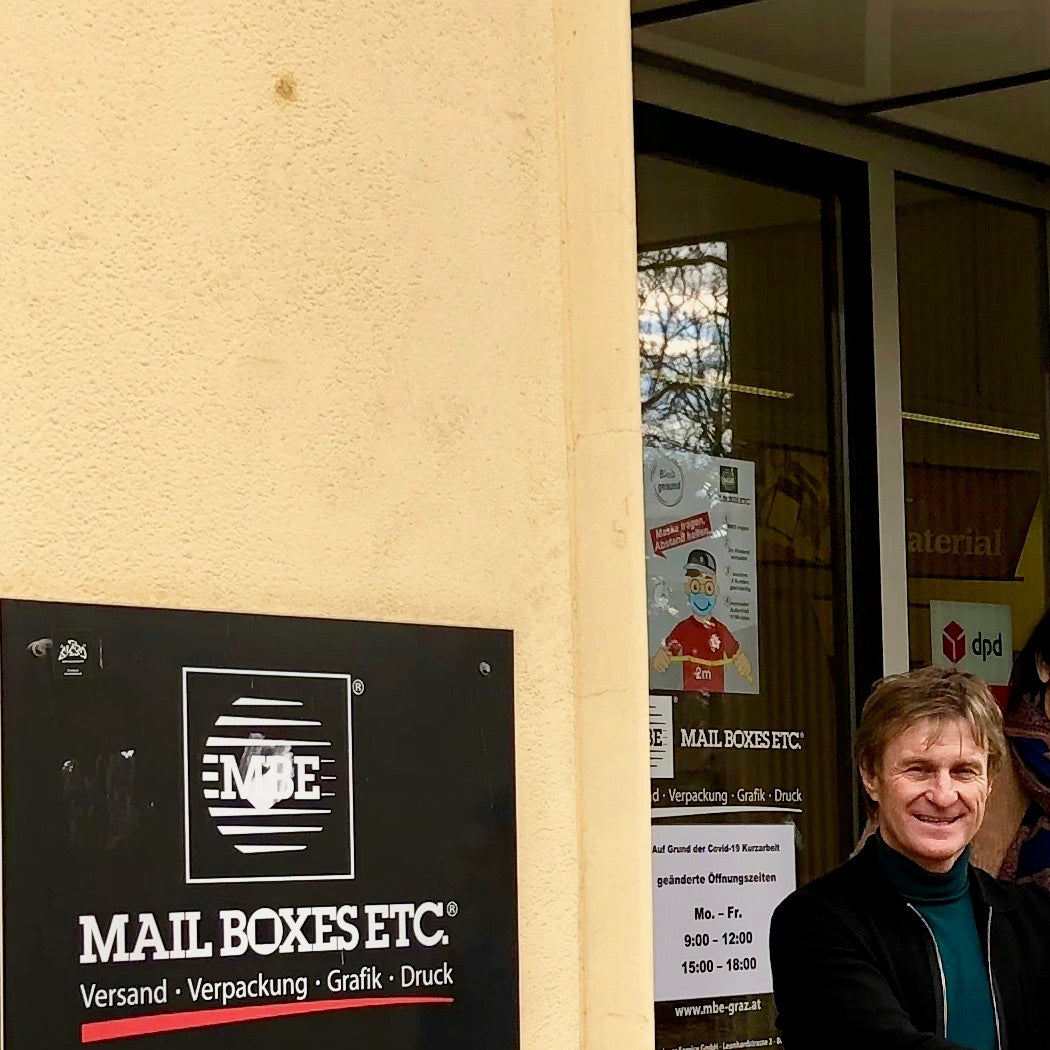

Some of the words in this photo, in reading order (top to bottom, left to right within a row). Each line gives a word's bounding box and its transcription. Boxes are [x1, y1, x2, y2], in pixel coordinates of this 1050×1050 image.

[907, 527, 1003, 557] aterial
[971, 631, 1003, 662] dpd
[649, 728, 663, 747] BE
[680, 728, 723, 748] MAIL
[723, 728, 771, 750] BOXES
[218, 752, 321, 801] MBE
[668, 787, 729, 806] Verpackung
[736, 787, 767, 803] Grafik
[773, 788, 803, 803] Druck
[651, 844, 666, 854] Auf
[667, 844, 692, 854] Grund
[692, 844, 706, 853] der
[707, 843, 741, 853] Covid-19
[741, 842, 781, 853] Kurzarbeit
[656, 873, 706, 888] geänderte
[707, 871, 777, 886] Öffnungszeiten
[694, 907, 715, 920] Mo.
[727, 905, 743, 919] Fr.
[79, 911, 213, 964] MAIL
[220, 904, 360, 956] BOXES
[684, 932, 710, 948] 9:00
[721, 931, 753, 946] 12:00
[681, 959, 714, 975] 15:00
[725, 957, 757, 971] 18:00
[79, 978, 168, 1009] Versand
[188, 973, 308, 1006] Verpackung
[327, 966, 383, 992] Grafik
[401, 962, 454, 987] Druck
[674, 998, 762, 1018] www.mbe-graz.at
